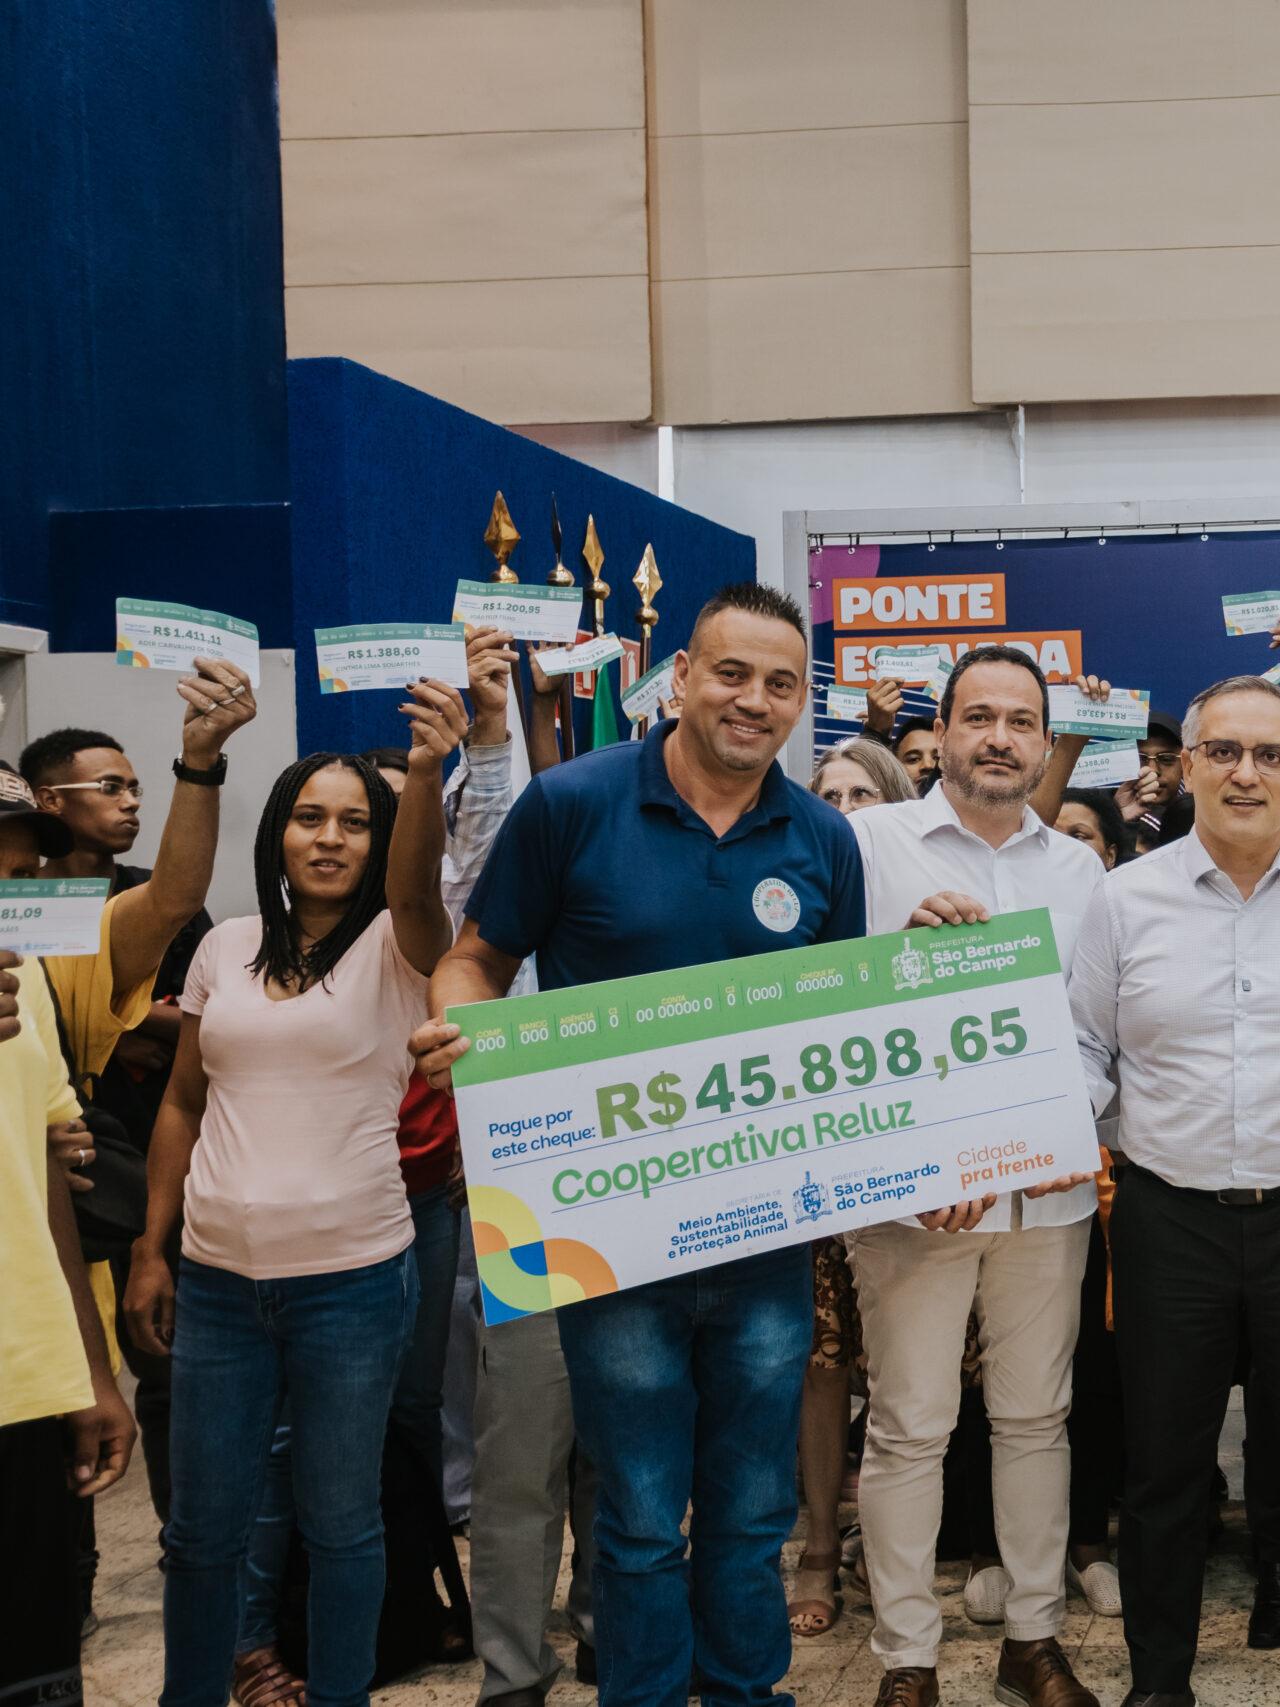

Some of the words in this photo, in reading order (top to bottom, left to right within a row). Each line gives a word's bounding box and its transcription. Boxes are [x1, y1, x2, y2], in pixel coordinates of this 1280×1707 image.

[482, 602, 494, 611] R$
[496, 602, 541, 614] 1.200,95
[840, 583, 994, 623] PONTE
[153, 626, 170, 637] R$
[173, 628, 222, 646] 1.411,11
[348, 649, 364, 659] R$
[366, 647, 420, 658] 1.388,60
[929, 935, 985, 950] PREFEITURA
[931, 944, 964, 965] São
[965, 934, 1042, 960] Bernardo
[934, 964, 956, 980] do
[958, 953, 1017, 975] Campo
[475, 1035, 506, 1053] 000
[520, 1027, 549, 1045] 000
[560, 1019, 597, 1038] 0000
[746, 982, 783, 1005] (000)
[795, 973, 844, 993] 000000
[696, 1007, 1028, 1114] 45.898,65
[488, 1115, 543, 1139] Pague
[546, 1109, 573, 1130] por
[491, 1141, 528, 1159] este
[530, 1126, 597, 1150] cheque:
[552, 1123, 807, 1205] Cooperativa
[812, 1099, 916, 1146] Reluz
[957, 1139, 1028, 1167] Cidade
[831, 1165, 885, 1183] PREFEITURA
[834, 1178, 864, 1197] São
[867, 1163, 941, 1190] Bernardo
[960, 1166, 994, 1190] pra
[996, 1152, 1055, 1177] frente
[836, 1195, 856, 1212] do
[859, 1183, 917, 1207] Campo
[668, 1250, 677, 1259] e
[679, 1234, 741, 1256] Proteção
[743, 1218, 788, 1240] Animal
[670, 1210, 784, 1246] Sustentabilidade
[678, 1216, 713, 1232] Meio
